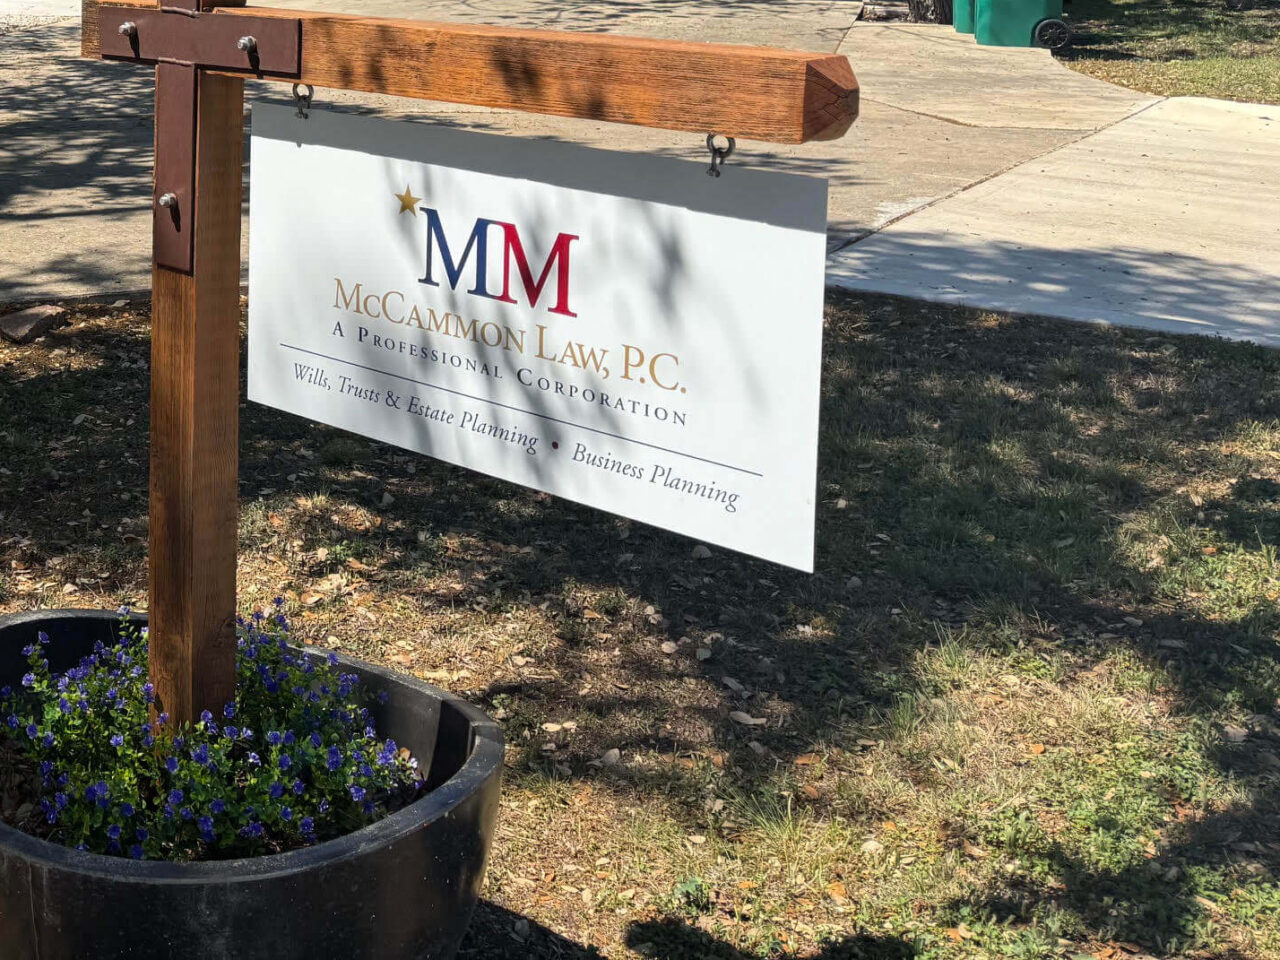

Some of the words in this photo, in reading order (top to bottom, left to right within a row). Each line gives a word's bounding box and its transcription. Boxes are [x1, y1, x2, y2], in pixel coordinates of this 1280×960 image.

[418, 206, 580, 318] MM
[332, 320, 345, 338] A
[358, 326, 504, 379] PROFESSIONAL
[516, 367, 688, 427] CORPORATION
[534, 324, 611, 380] LAW,
[620, 343, 688, 394] P.C.
[293, 362, 332, 392] Wills,
[338, 375, 381, 404] Trusts
[384, 390, 401, 410] &
[406, 395, 455, 425] Estate
[459, 411, 539, 456] Planning
[571, 442, 645, 480] Business
[648, 464, 741, 514] Planning
